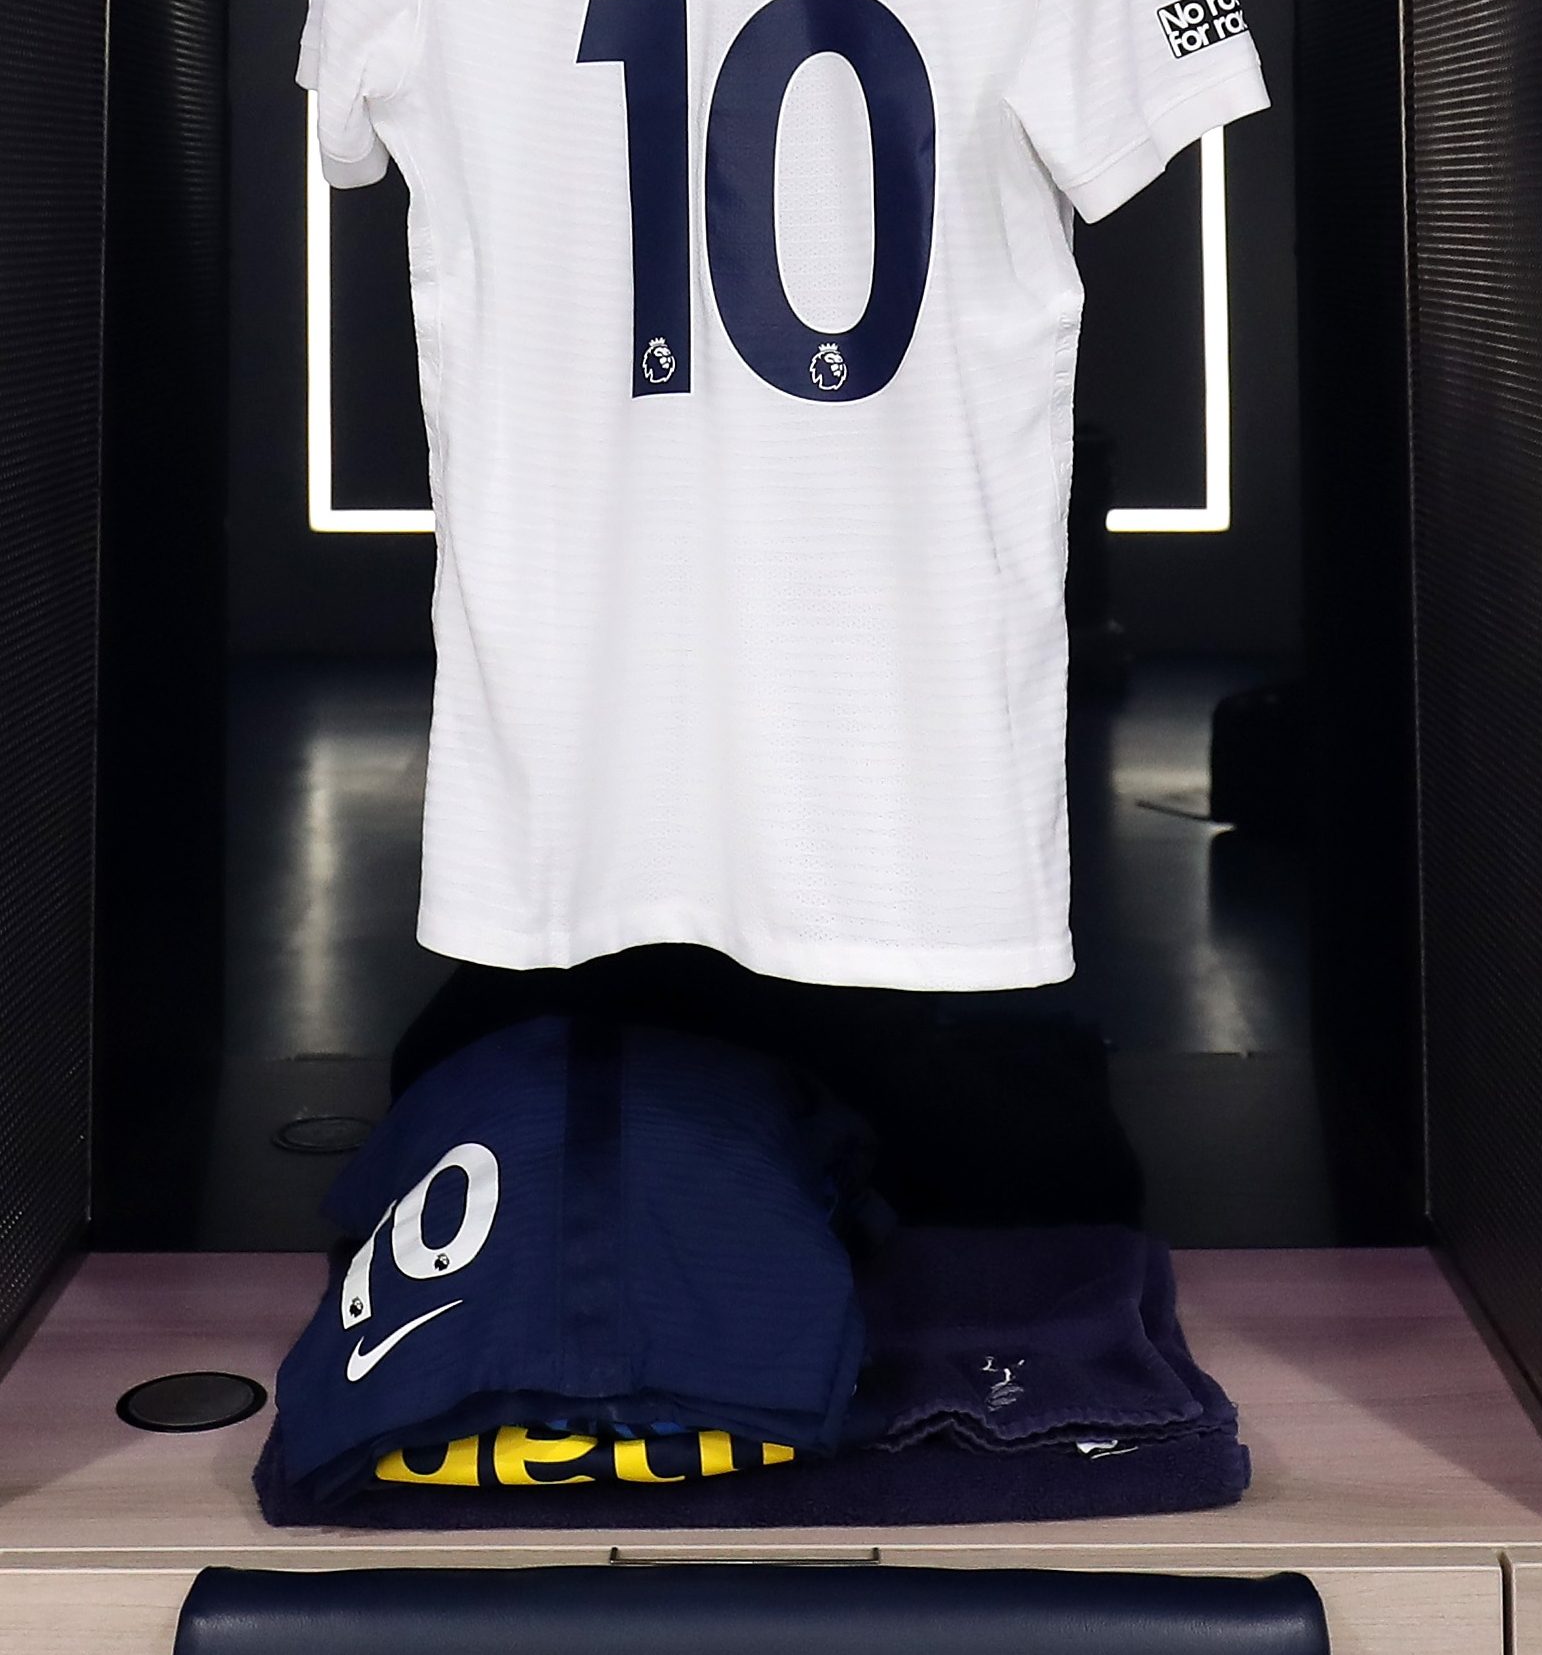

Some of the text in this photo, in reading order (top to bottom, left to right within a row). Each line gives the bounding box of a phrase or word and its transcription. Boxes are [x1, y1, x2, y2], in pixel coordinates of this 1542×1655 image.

[1159, 2, 1205, 36] No
[1169, 23, 1210, 57] for
[341, 1142, 499, 1329] 10
